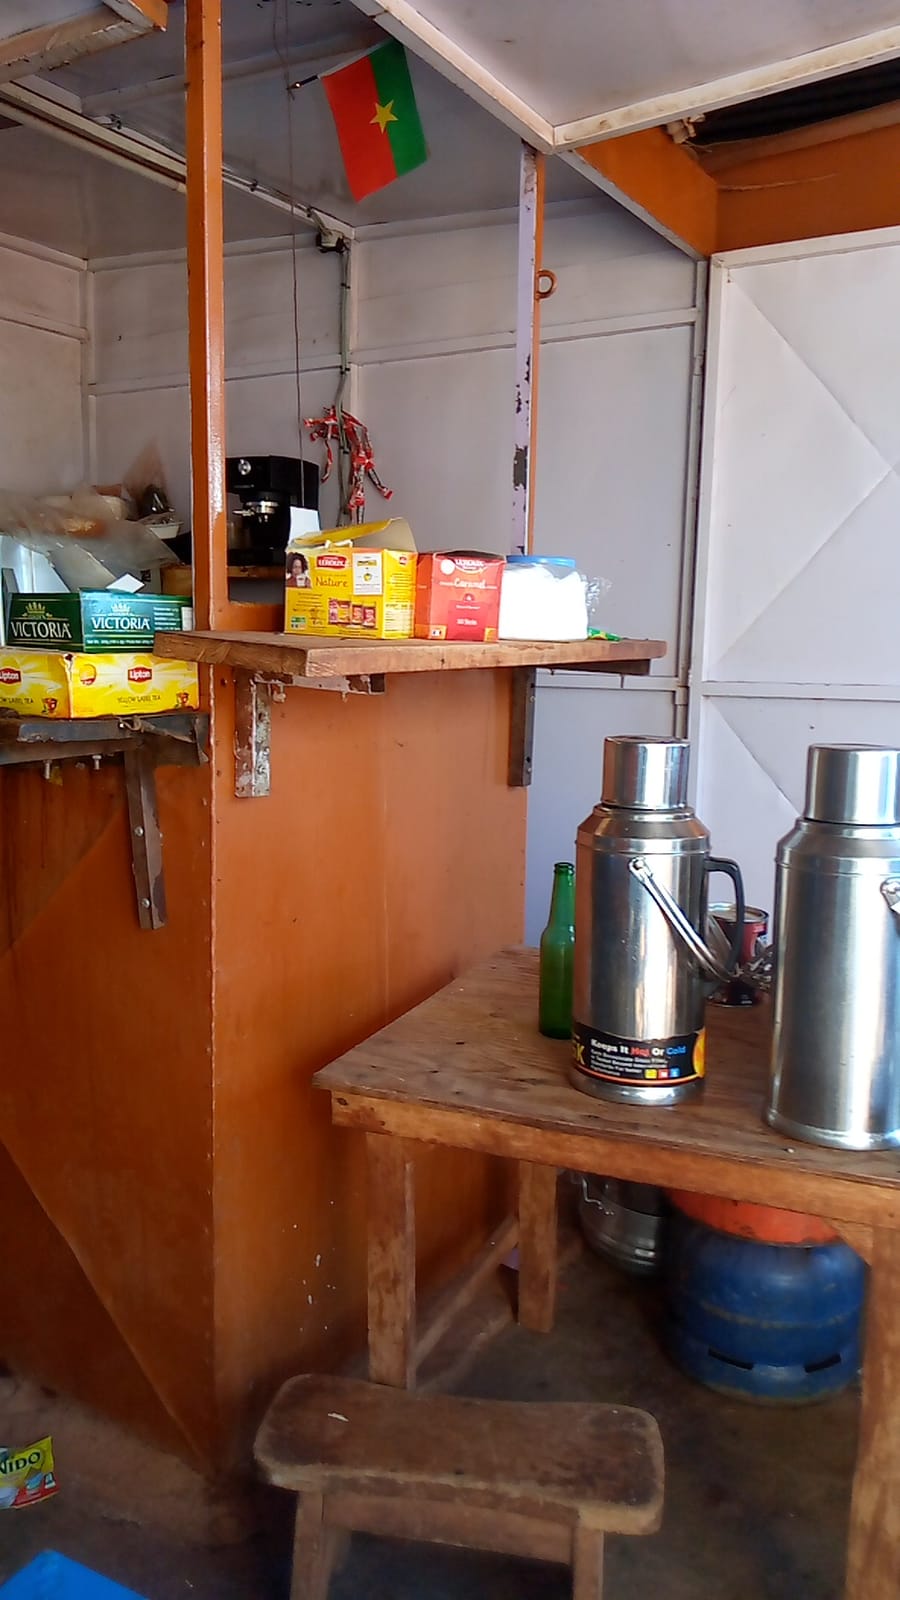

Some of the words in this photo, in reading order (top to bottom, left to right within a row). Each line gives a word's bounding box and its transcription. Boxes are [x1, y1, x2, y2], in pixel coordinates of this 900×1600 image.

[315, 576, 348, 587] Nature
[454, 578, 486, 589] Caramel
[91, 617, 150, 630] VICTORIA
[10, 621, 72, 639] VICTORIA
[129, 670, 151, 680] Lipton
[590, 1039, 619, 1053] Keeps
[620, 1044, 629, 1055] It
[652, 1047, 665, 1056] Or
[666, 1046, 686, 1055] Cold
